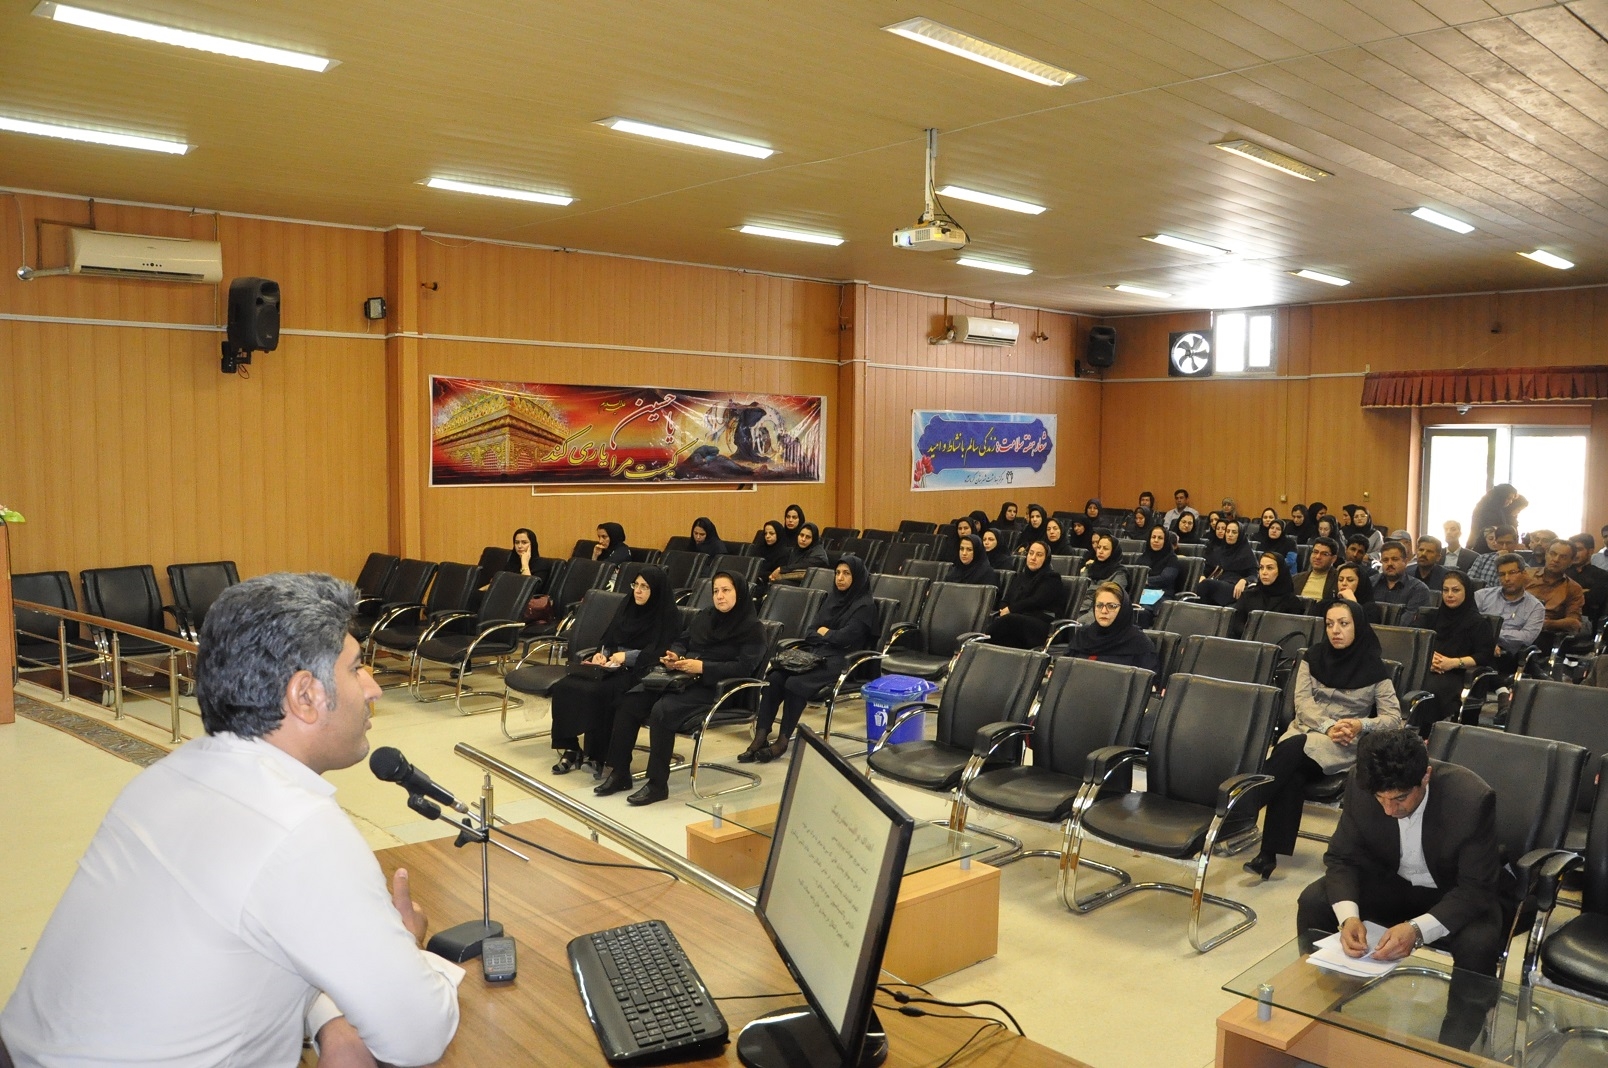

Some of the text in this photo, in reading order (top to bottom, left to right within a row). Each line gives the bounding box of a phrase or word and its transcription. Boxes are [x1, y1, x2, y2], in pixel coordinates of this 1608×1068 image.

[541, 424, 699, 479] کیست مرا یاری کند
[927, 440, 942, 458] امید
[978, 426, 997, 457] زندگی
